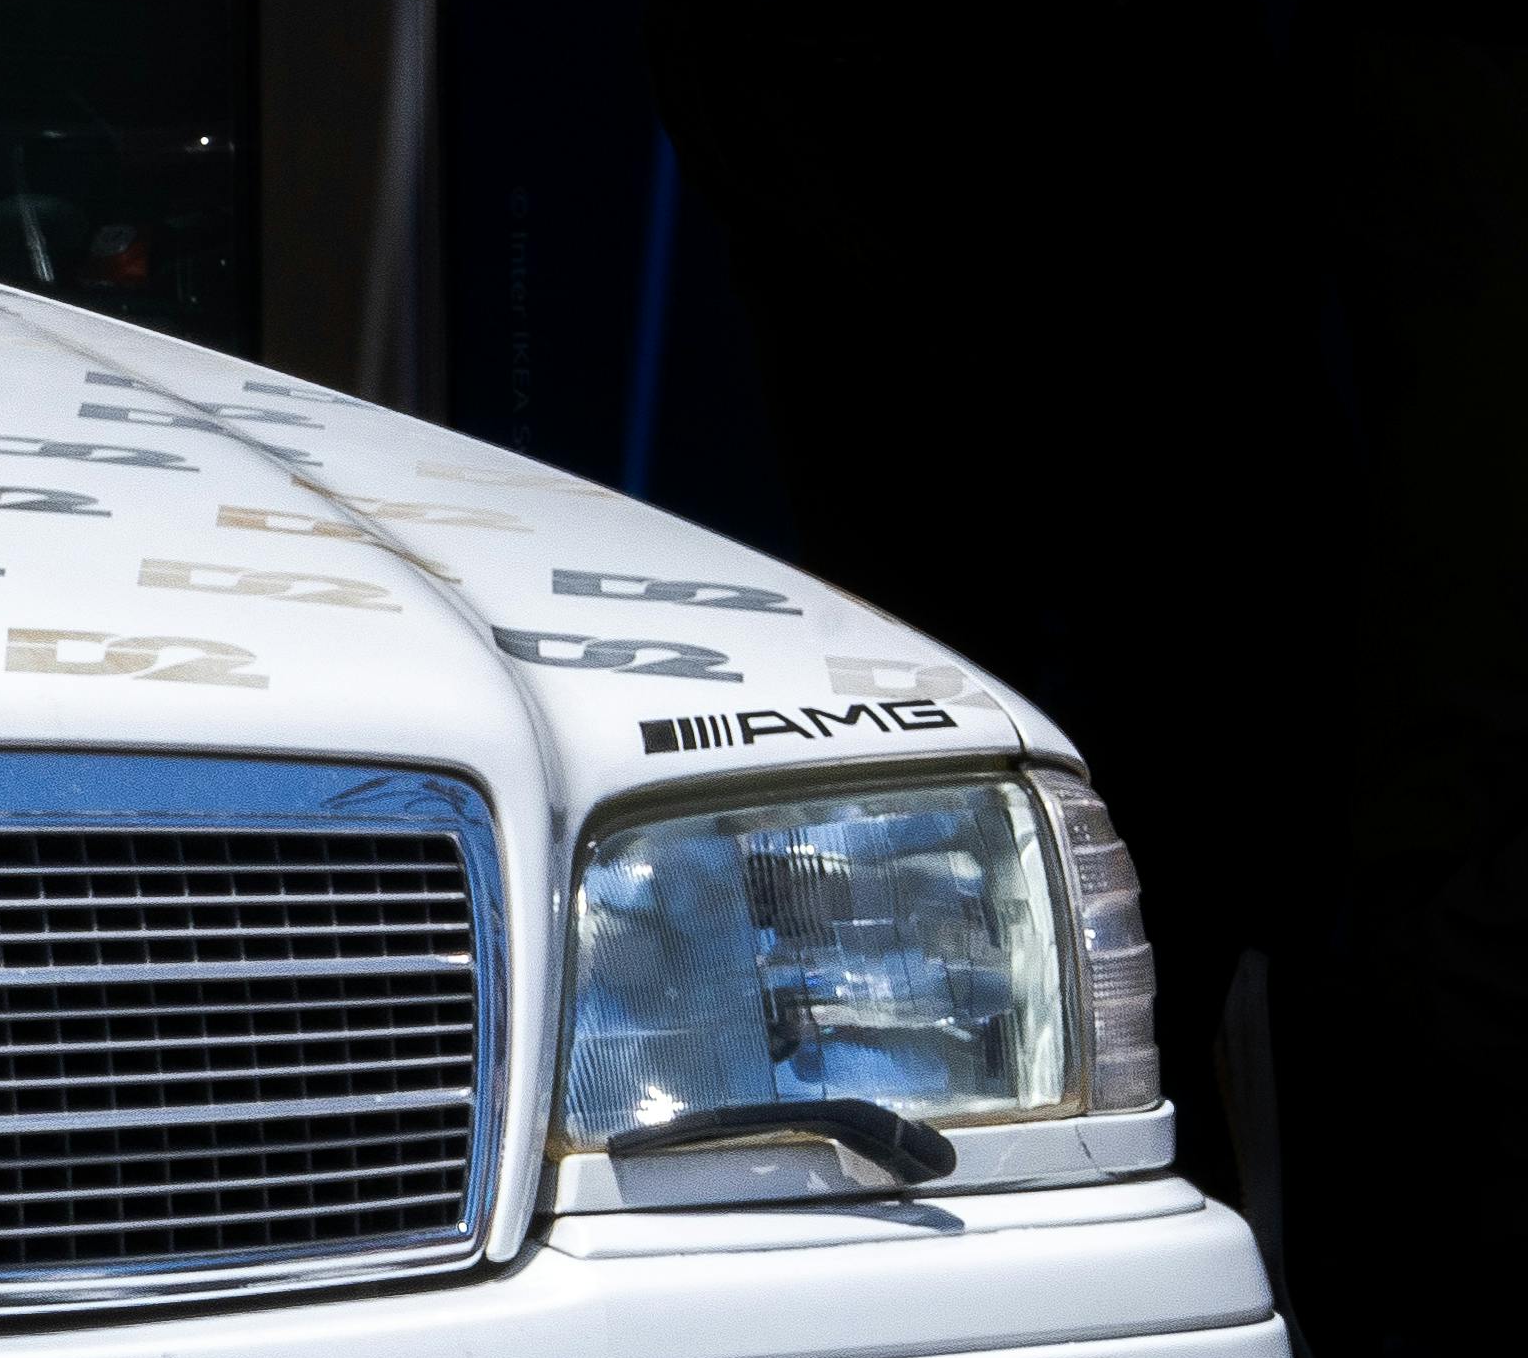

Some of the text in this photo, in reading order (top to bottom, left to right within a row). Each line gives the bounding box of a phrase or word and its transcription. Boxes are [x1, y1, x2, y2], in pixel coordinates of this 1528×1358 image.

[137, 557, 403, 614] D2
[552, 568, 804, 616] D2
[4, 626, 269, 690] D2
[490, 623, 745, 685] D2
[739, 698, 960, 746] AMG
